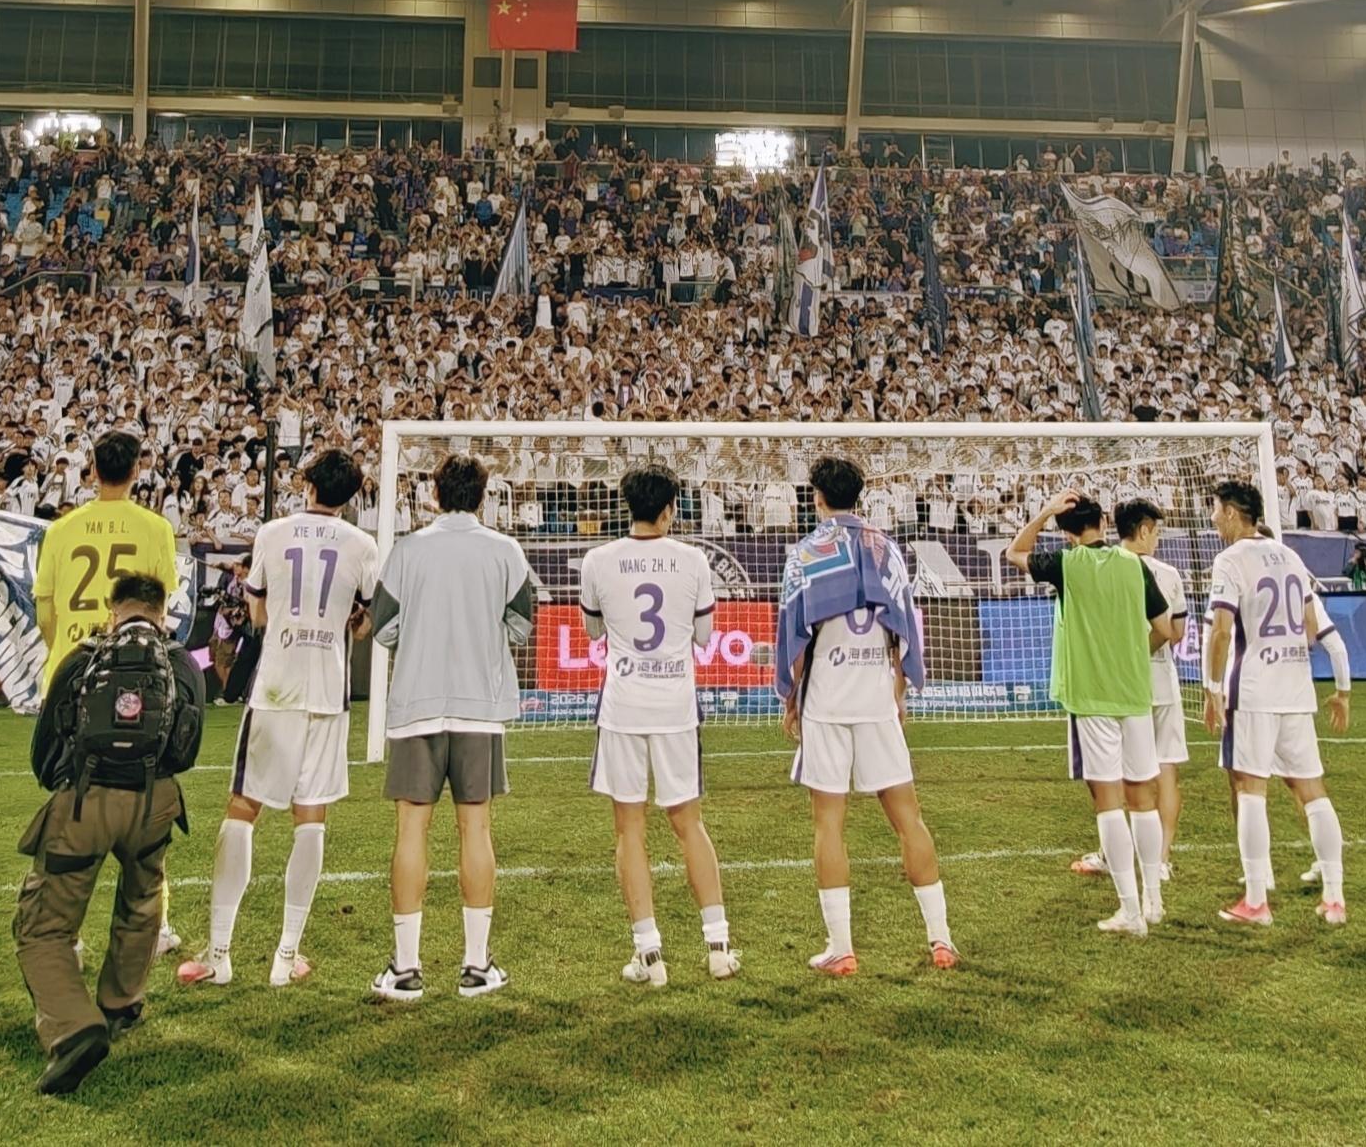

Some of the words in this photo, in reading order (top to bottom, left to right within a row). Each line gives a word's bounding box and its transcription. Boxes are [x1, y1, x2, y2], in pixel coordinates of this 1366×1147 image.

[85, 521, 104, 535] YAN
[293, 526, 309, 538] XIE
[619, 558, 647, 574] WANG
[284, 547, 339, 618] 11
[1256, 574, 1304, 638] 20
[633, 582, 666, 652] 3
[848, 647, 885, 661] 海泰控
